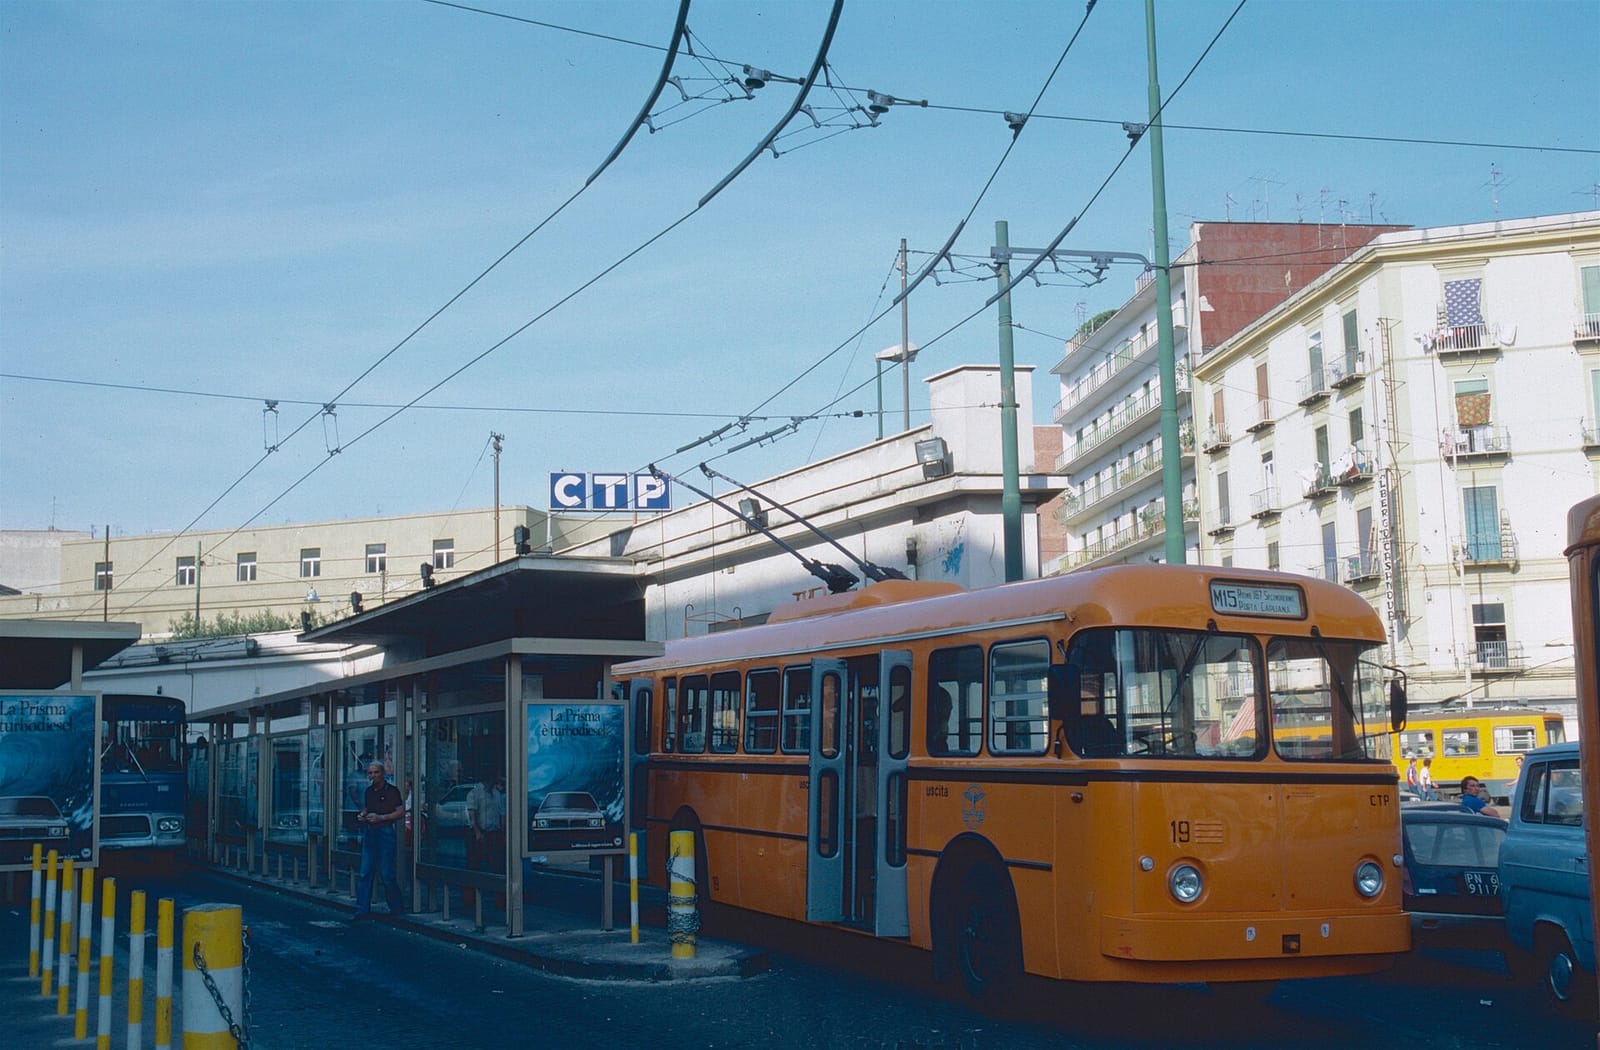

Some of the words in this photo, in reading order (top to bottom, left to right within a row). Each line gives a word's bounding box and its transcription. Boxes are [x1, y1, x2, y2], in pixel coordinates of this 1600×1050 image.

[554, 475, 666, 508] CTP
[1212, 589, 1238, 608] M15
[19, 700, 67, 716] Prisma
[550, 708, 563, 722] La
[565, 707, 601, 722] Prisma
[541, 723, 549, 737] è
[926, 784, 949, 798] uscita
[1369, 794, 1390, 806] CTP
[1170, 820, 1190, 843] 19
[1467, 873, 1482, 884] PN
